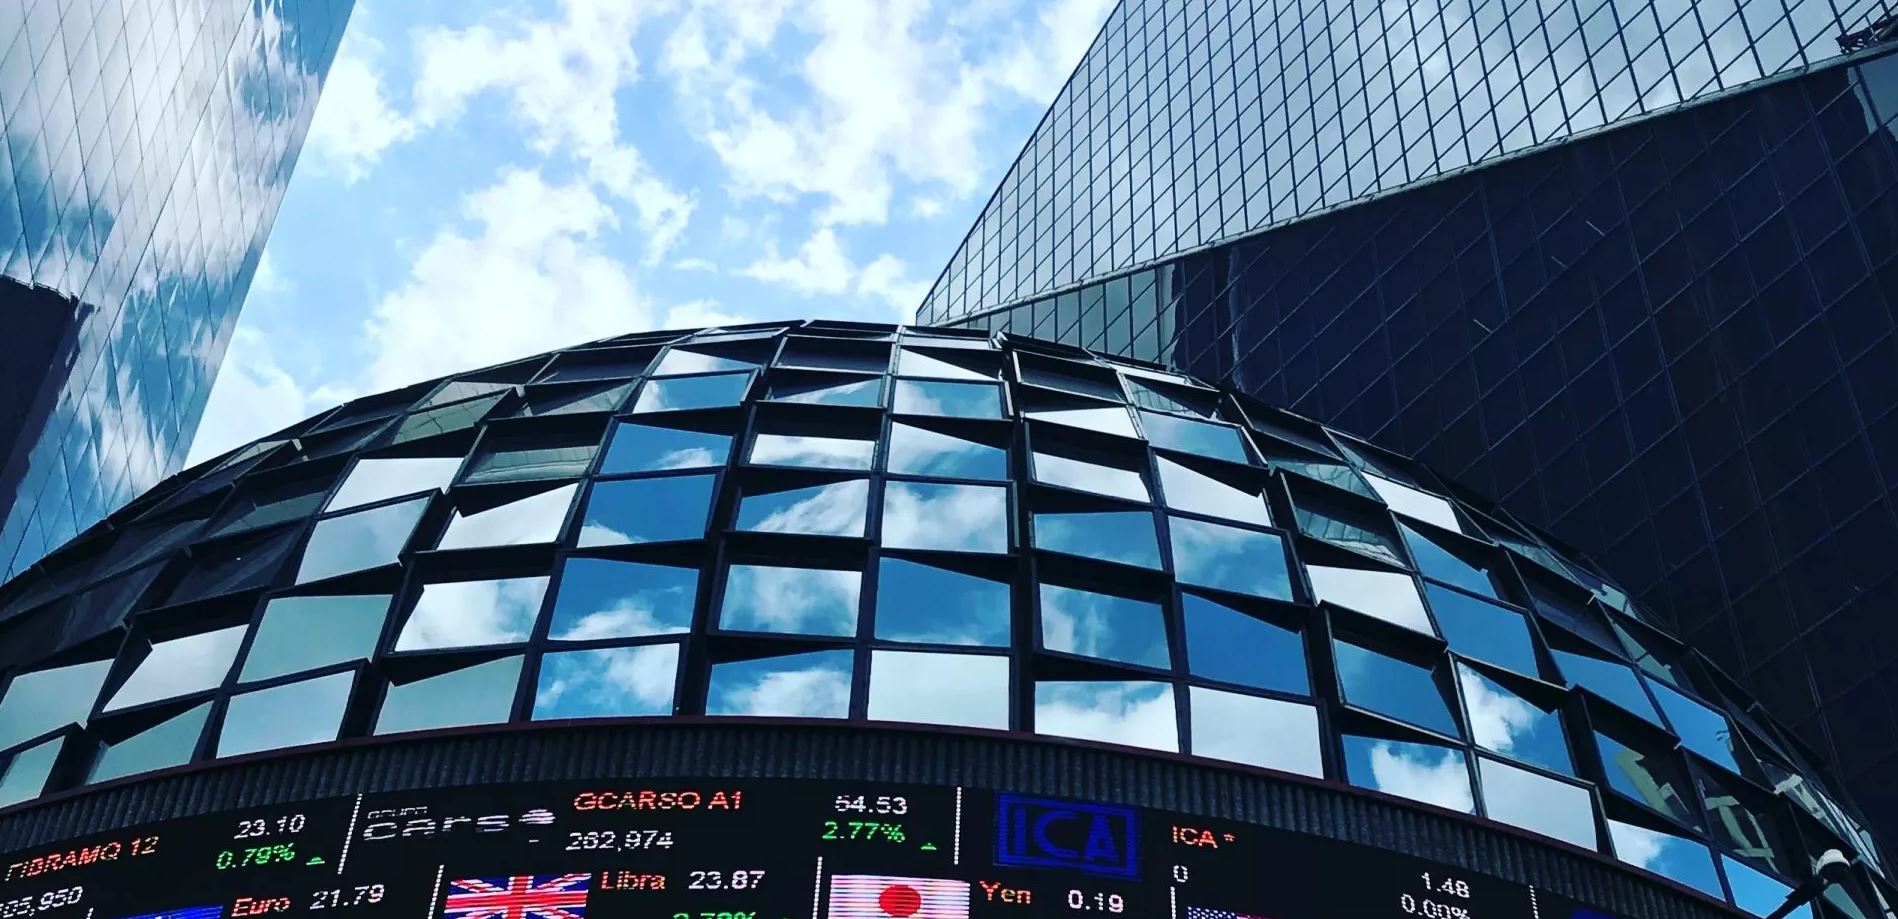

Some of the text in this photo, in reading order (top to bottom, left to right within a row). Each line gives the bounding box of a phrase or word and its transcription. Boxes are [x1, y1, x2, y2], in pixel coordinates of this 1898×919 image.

[573, 790, 742, 811] GCARSO A1
[233, 814, 306, 840] 23.10
[822, 821, 906, 843] 2.77%
[1014, 802, 1120, 864] ICA
[1173, 826, 1218, 849] ICA
[131, 836, 159, 856] 12
[216, 842, 295, 870] 0.79%
[601, 871, 666, 890] Libra
[689, 870, 766, 890] 23.87
[1173, 865, 1189, 883] 0
[1421, 872, 1470, 898] 1.48
[310, 884, 385, 910] 21.79
[979, 880, 1031, 904] Yen
[1068, 889, 1124, 913] 0.19
[231, 897, 291, 917] Euro
